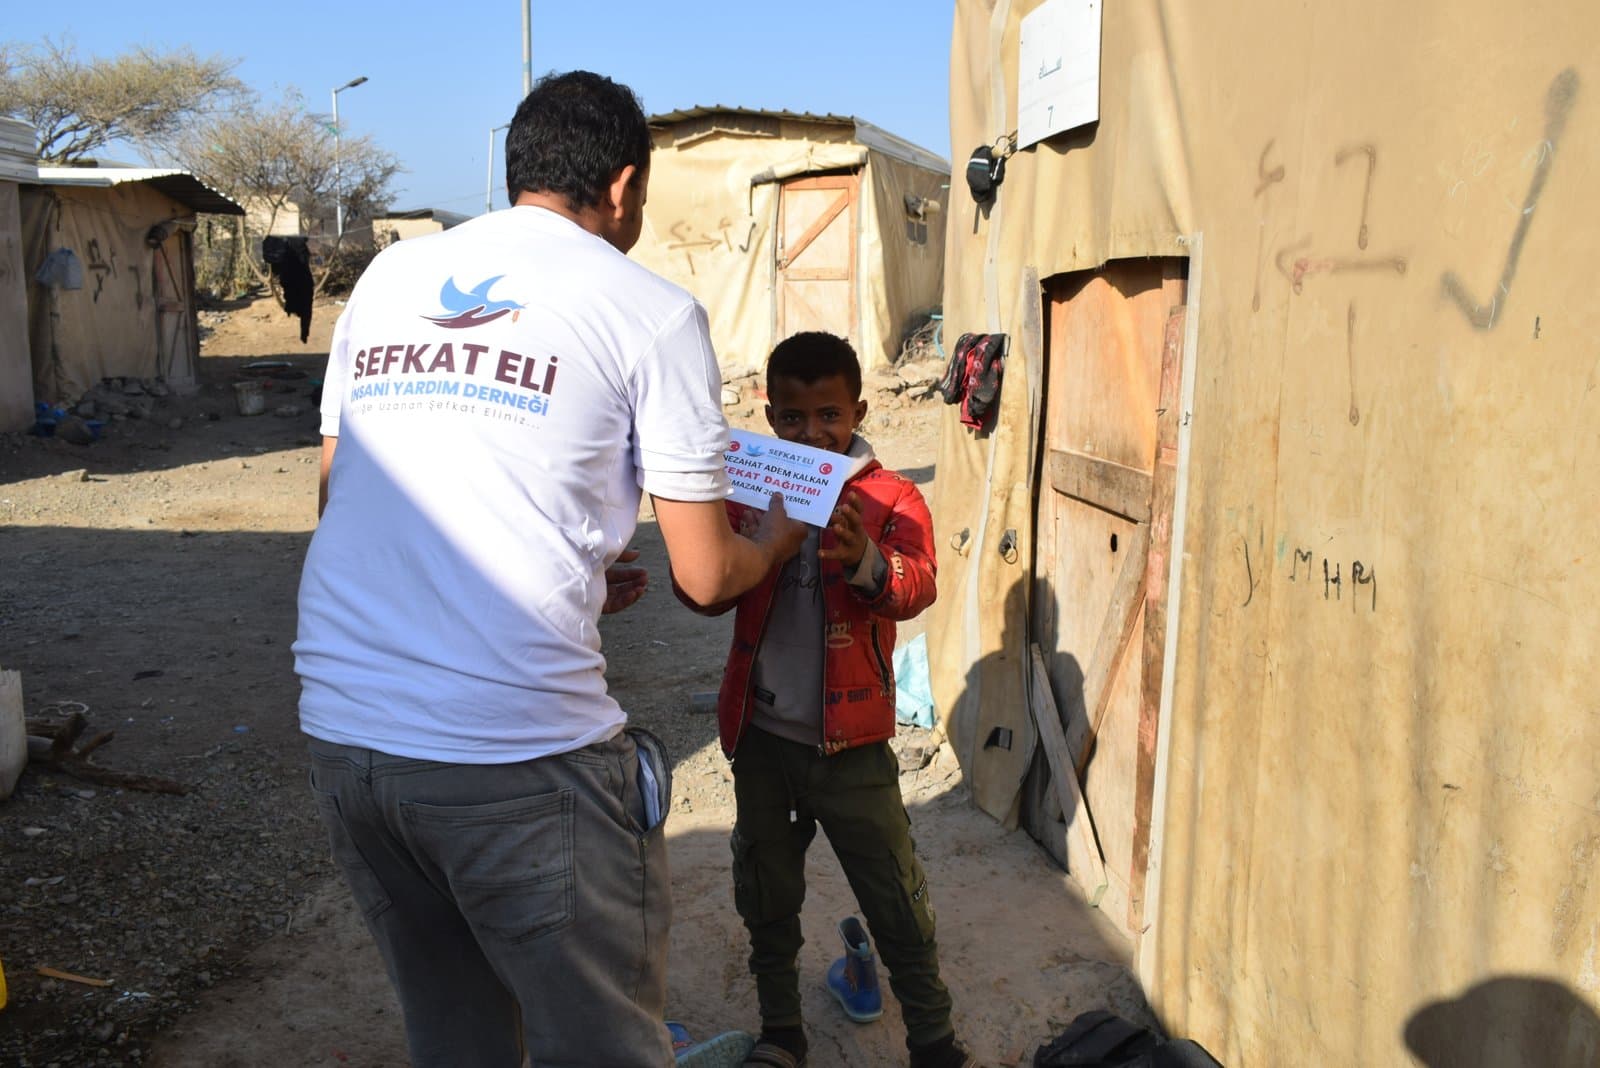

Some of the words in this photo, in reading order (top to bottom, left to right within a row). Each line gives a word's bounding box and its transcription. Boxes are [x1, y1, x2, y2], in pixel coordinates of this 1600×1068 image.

[354, 342, 489, 381] ŞEFKAT
[494, 349, 560, 395] ELİ
[393, 380, 460, 396] YARDIM
[462, 383, 550, 417] DERNEĞİ
[724, 465, 760, 480] EKAT
[764, 476, 822, 496] DAĞITIMI
[764, 464, 792, 478] ADEM
[792, 472, 830, 486] KALKAN
[730, 480, 763, 493] MAZAN
[785, 495, 812, 507] YEMEN
